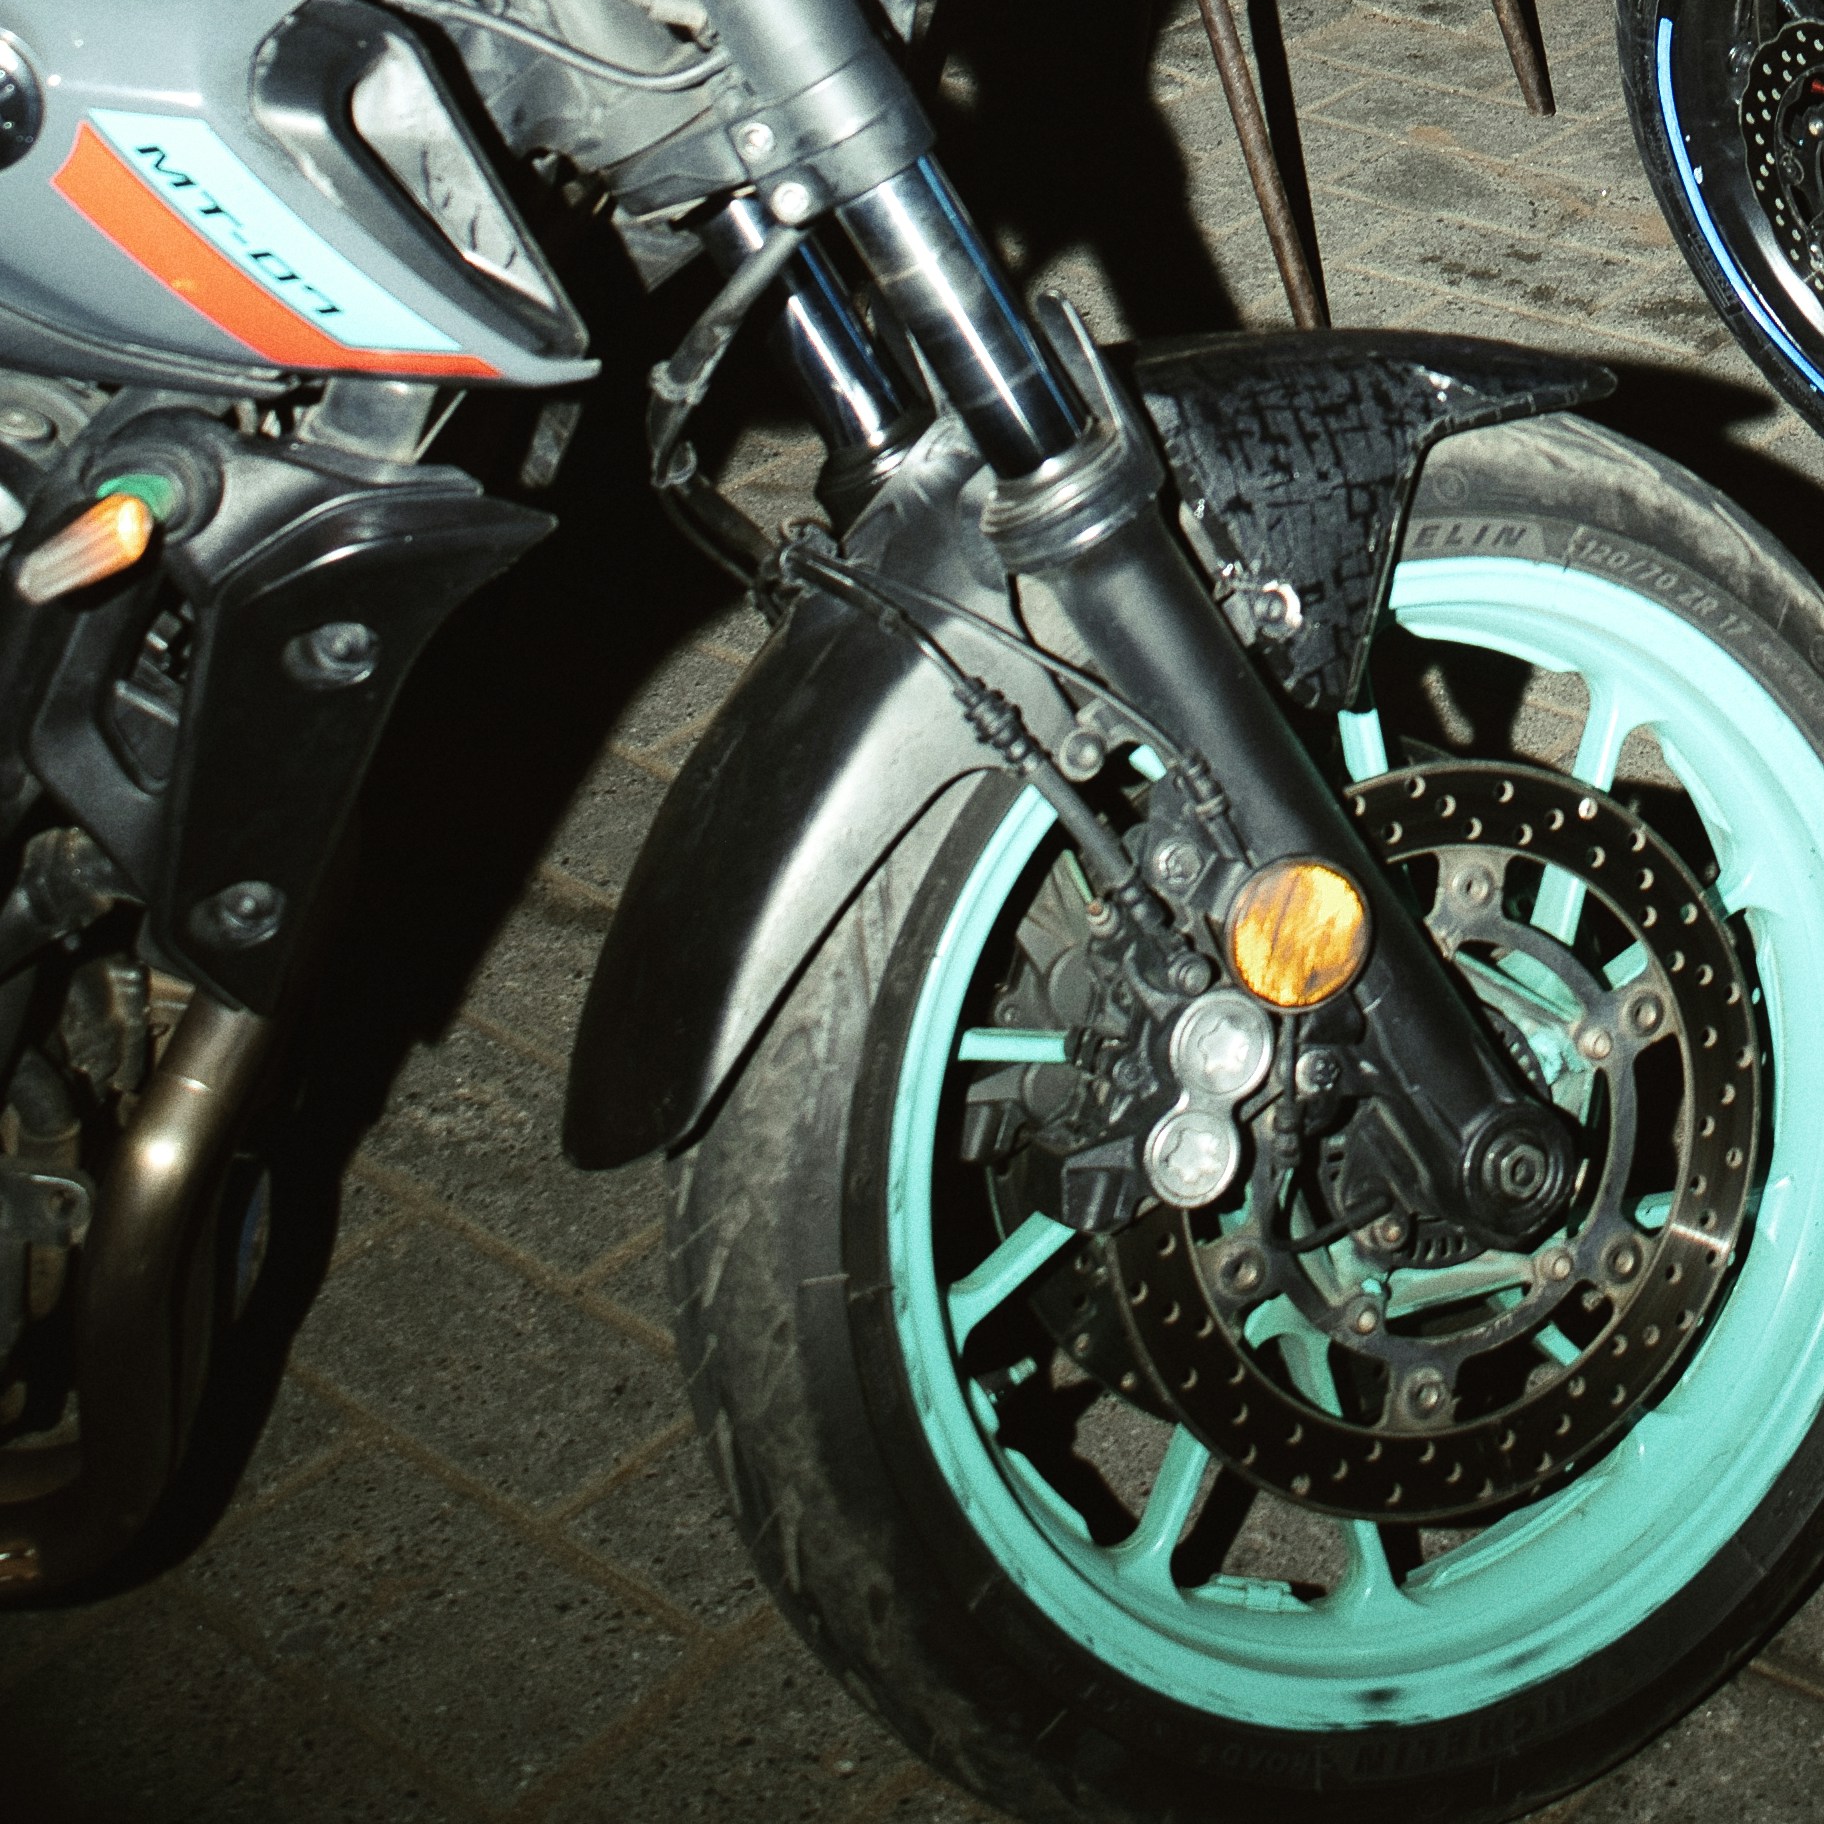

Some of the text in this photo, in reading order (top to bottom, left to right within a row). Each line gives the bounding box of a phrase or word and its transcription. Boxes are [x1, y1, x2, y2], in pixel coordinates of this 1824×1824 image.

[137, 147, 341, 314] MT-07
[1412, 524, 1528, 550] ELIN
[1578, 537, 1751, 637] 120/70 ZR 17
